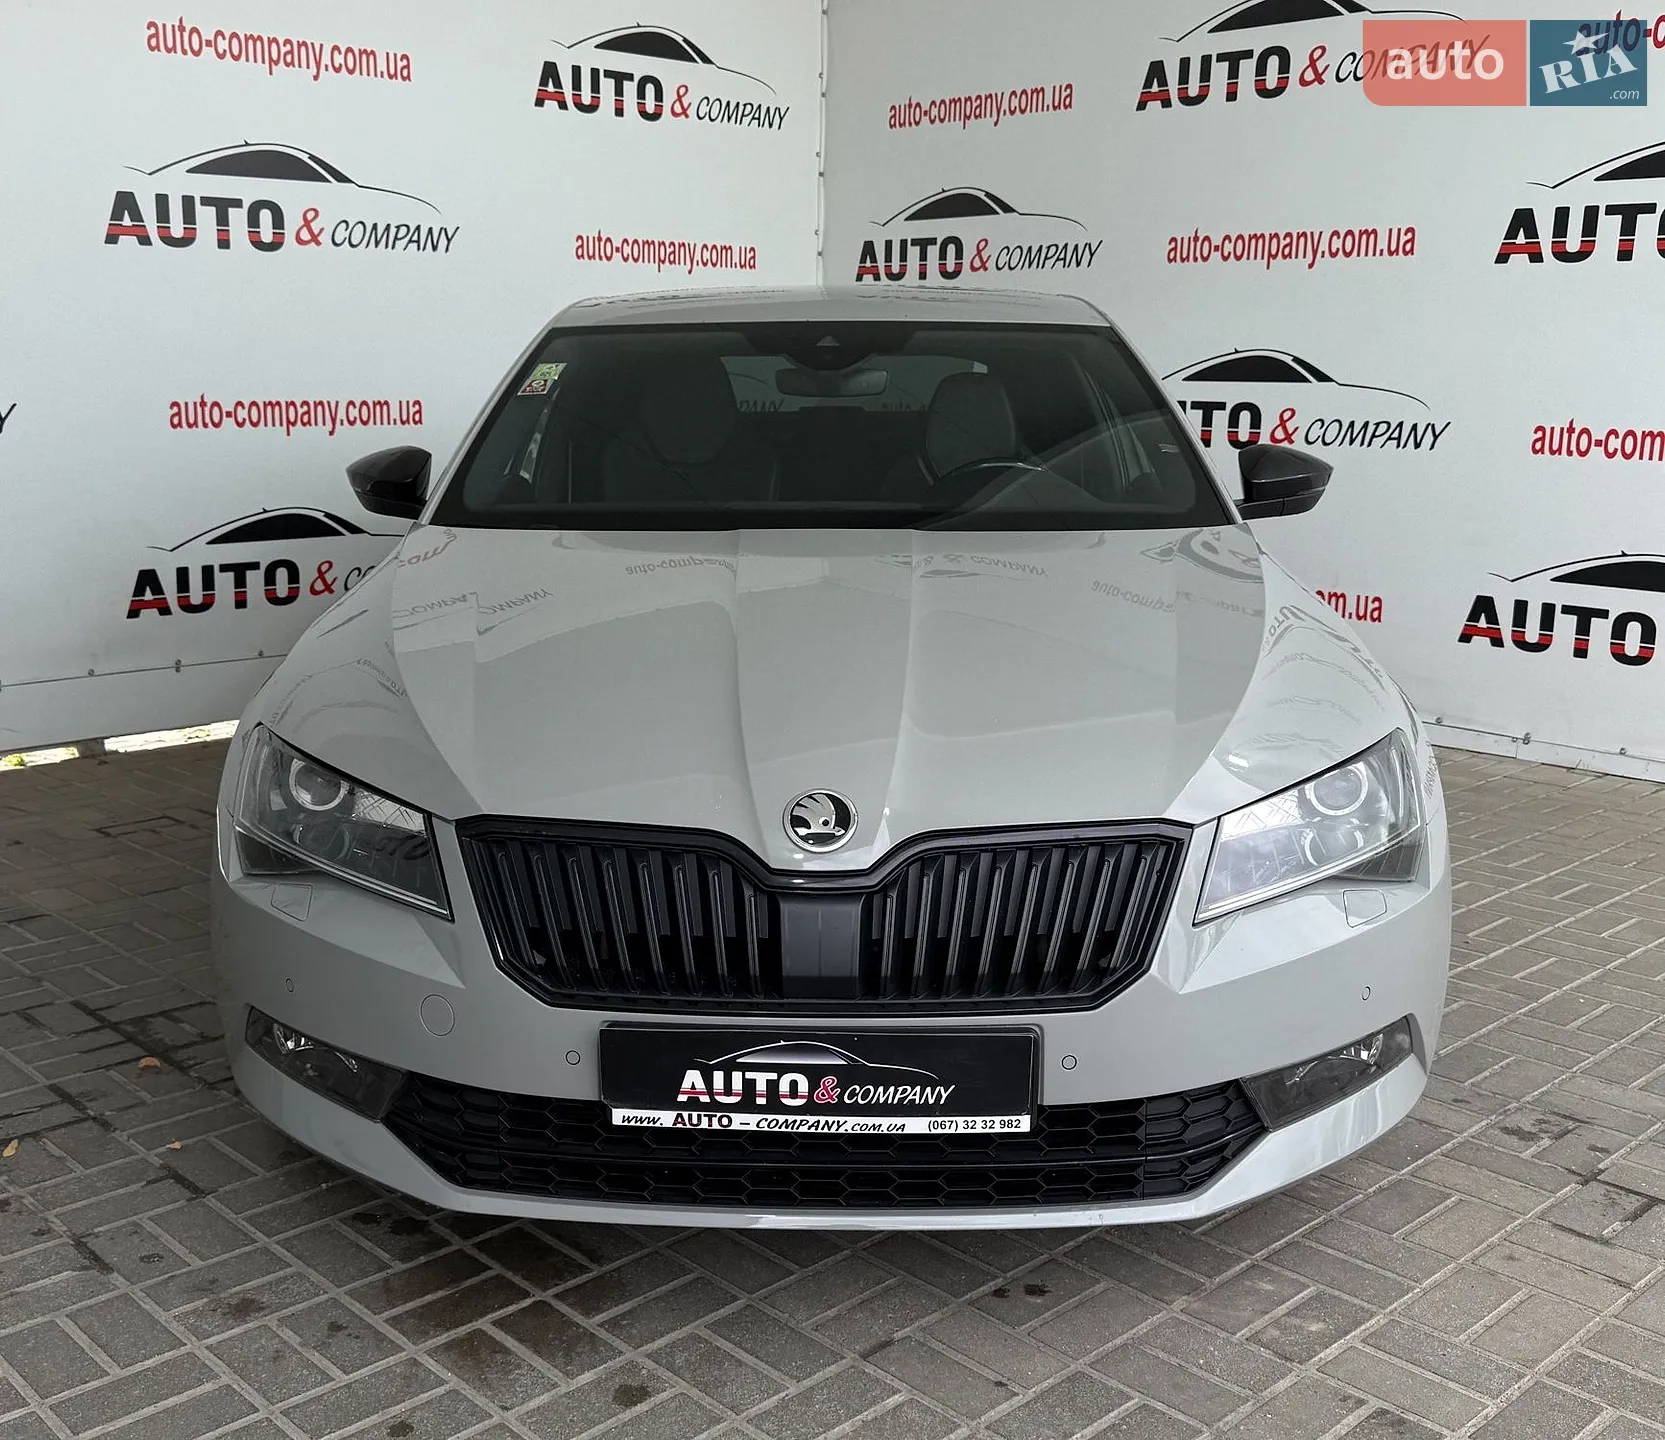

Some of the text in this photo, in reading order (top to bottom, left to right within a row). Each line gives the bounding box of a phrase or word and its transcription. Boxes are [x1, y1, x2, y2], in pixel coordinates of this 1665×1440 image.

[147, 17, 411, 82] auto-company.com.ua
[534, 60, 789, 131] AUTO & COMPANY
[1136, 45, 1291, 111] AUTO
[1299, 45, 1330, 87] &
[889, 84, 1073, 129] auto-company.com.ua
[104, 191, 460, 254] AUTO & COMPANY
[1494, 203, 1665, 264] AUT
[576, 230, 757, 275] auto-company.com.ua
[855, 236, 1103, 282] AUTO & COMPANY
[1167, 227, 1416, 270] auto-company.com.ua
[170, 393, 423, 436] auto-company.com.ua
[1269, 407, 1299, 446] &
[1303, 418, 1451, 451] COMPANY
[126, 559, 300, 619] AUTO
[309, 560, 338, 596] &
[1458, 595, 1657, 666] AUTO
[676, 1069, 955, 1107] AUTO & COMPANY
[621, 1114, 664, 1127] www.
[672, 1112, 733, 1129] AUTO
[927, 1119, 958, 1133] (067)
[962, 1119, 977, 1131] 32
[981, 1119, 996, 1131] 32
[999, 1118, 1021, 1130] 982
